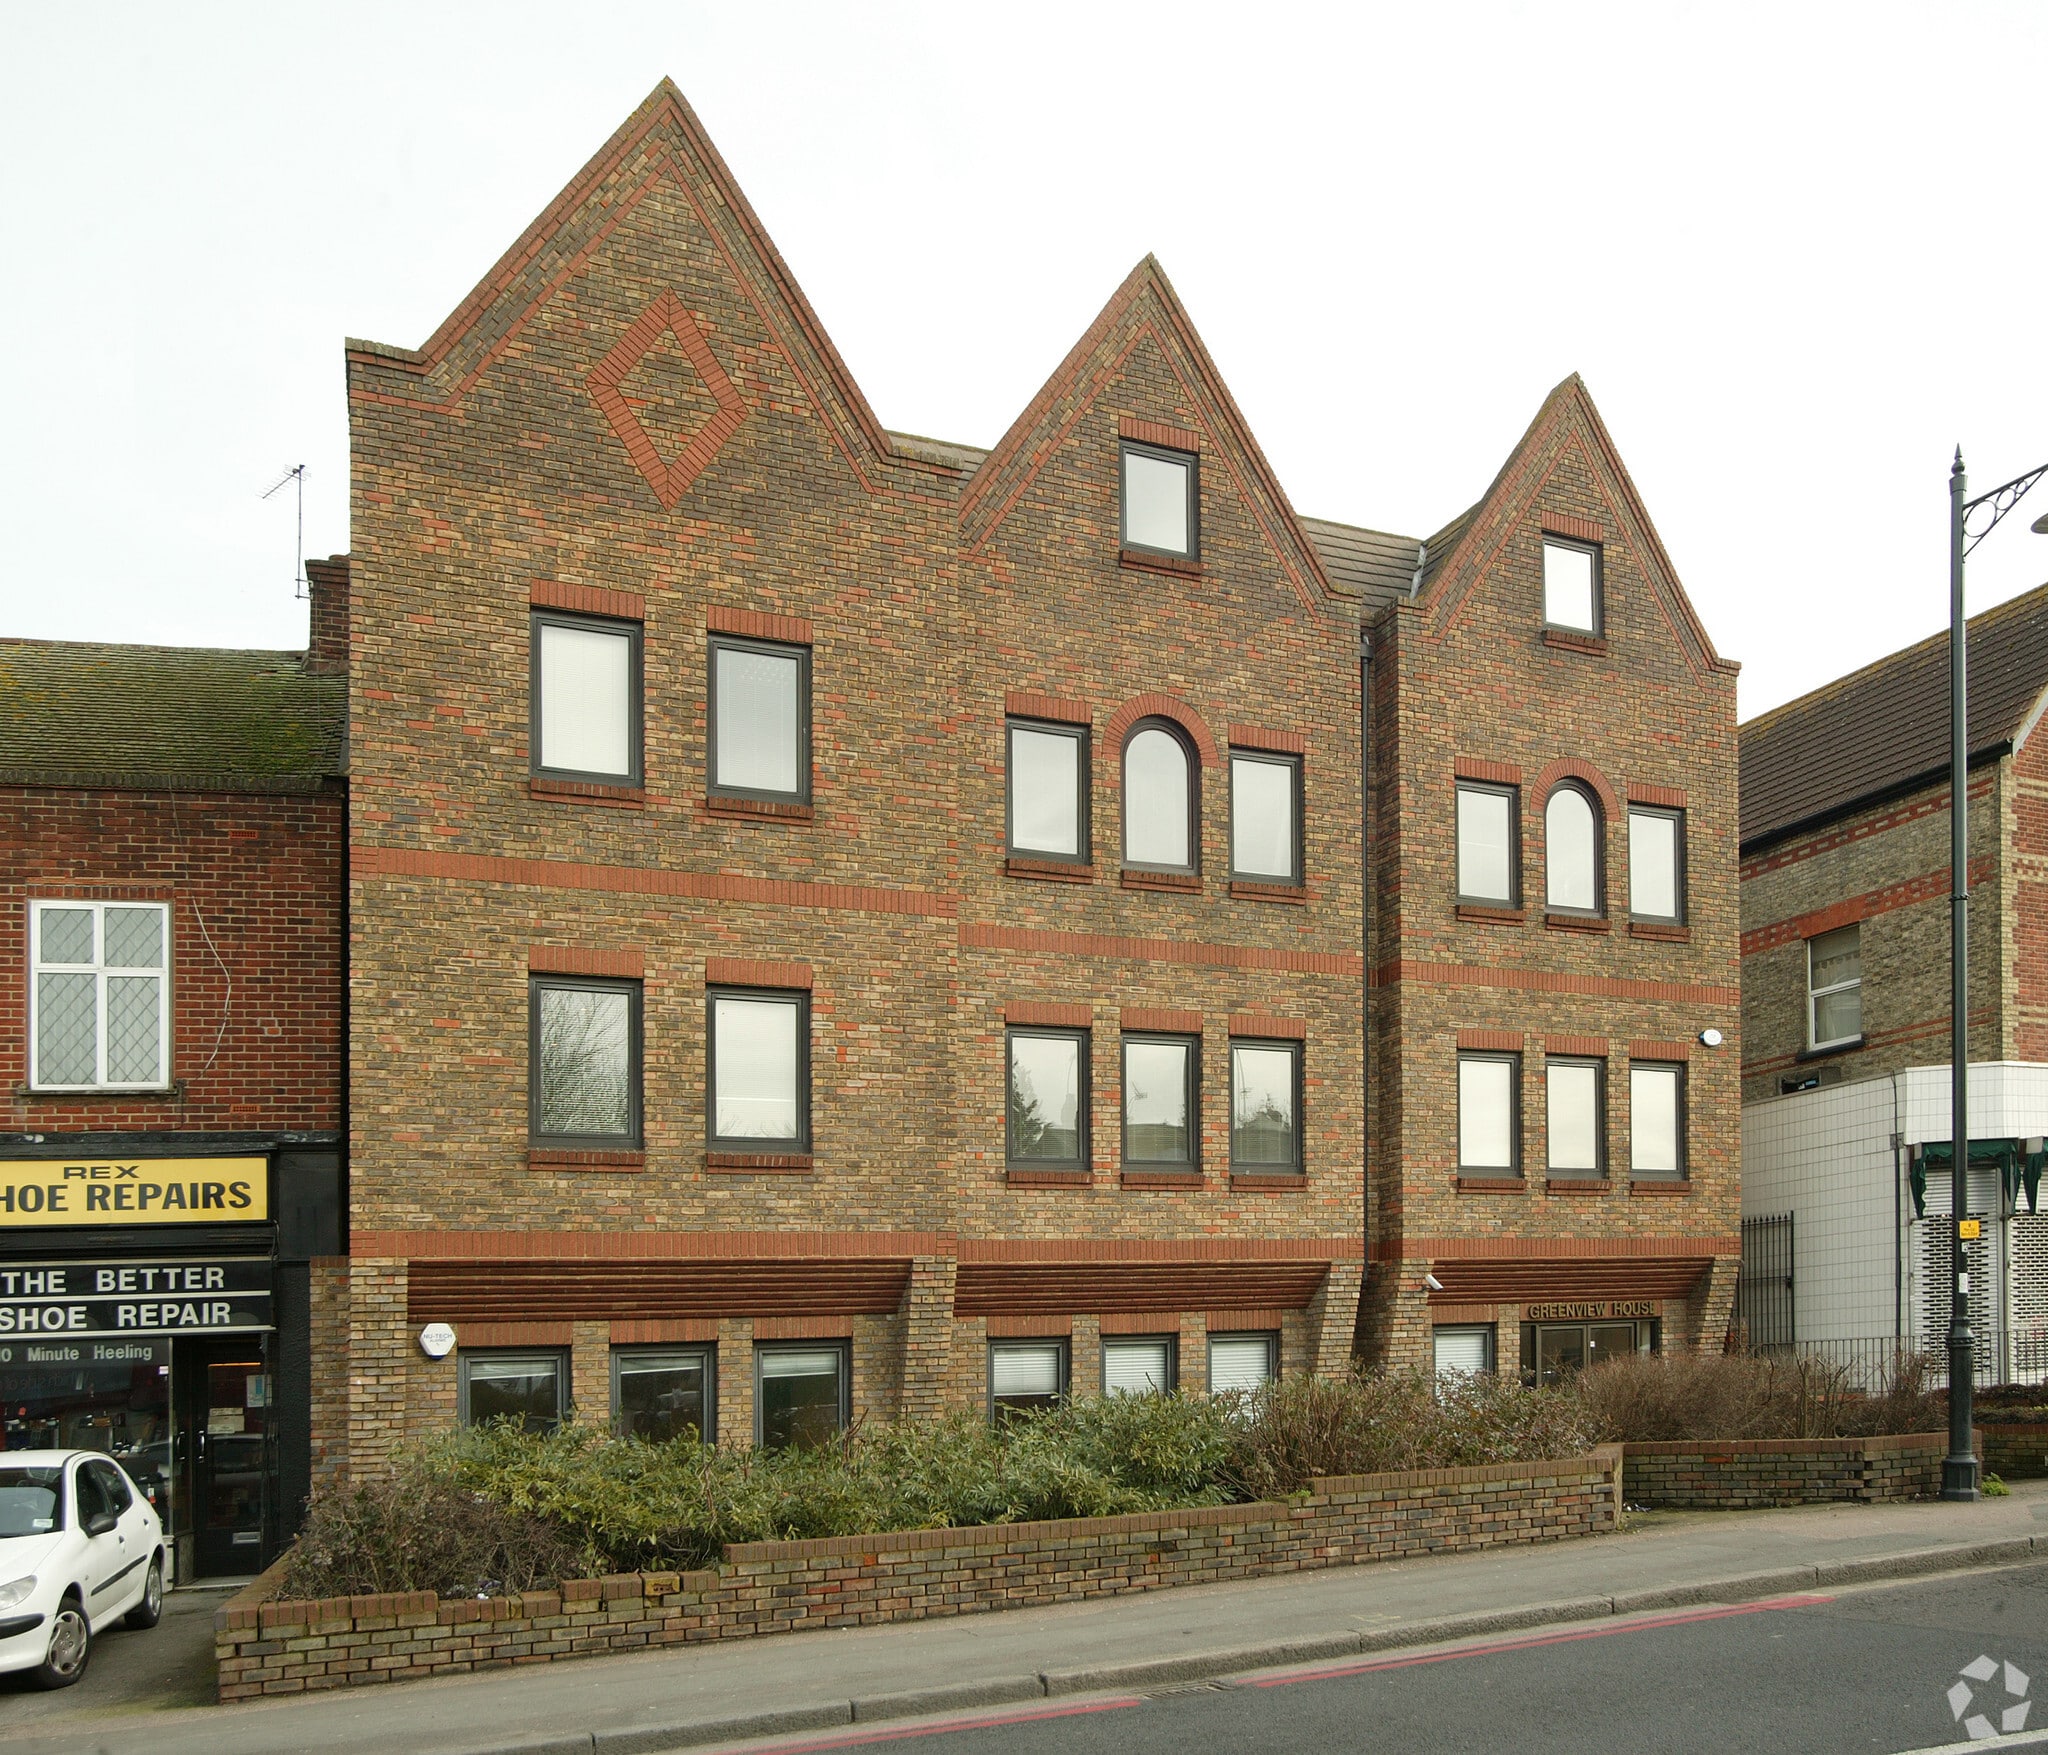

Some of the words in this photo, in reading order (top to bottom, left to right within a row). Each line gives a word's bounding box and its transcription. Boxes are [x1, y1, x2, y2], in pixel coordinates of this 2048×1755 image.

[63, 1165, 140, 1180] REX
[86, 1181, 251, 1211] REPAIRS
[1, 1270, 67, 1294] THE
[96, 1267, 225, 1292] BETTER
[0, 1306, 87, 1331] SHOE
[117, 1302, 231, 1327] REPAIR
[1529, 1302, 1606, 1319] GREENVIEW
[1613, 1300, 1655, 1316] HOUSE
[27, 1346, 80, 1362] Minute
[93, 1343, 153, 1361] Heeling
